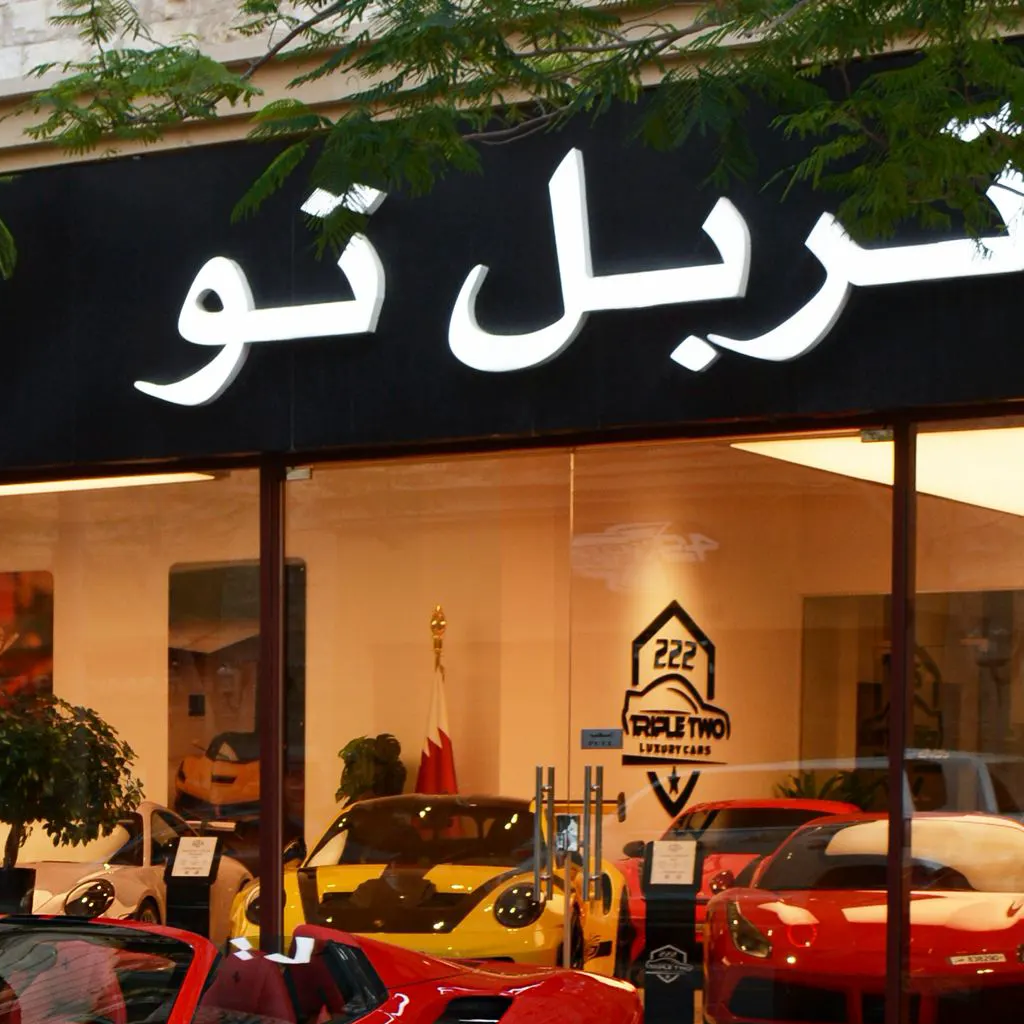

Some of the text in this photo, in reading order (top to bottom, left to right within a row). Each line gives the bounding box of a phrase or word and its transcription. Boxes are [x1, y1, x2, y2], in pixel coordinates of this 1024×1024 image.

[654, 638, 697, 671] 222
[629, 714, 726, 740] TRIPLE TWO
[639, 743, 711, 755] LUXURY CARS
